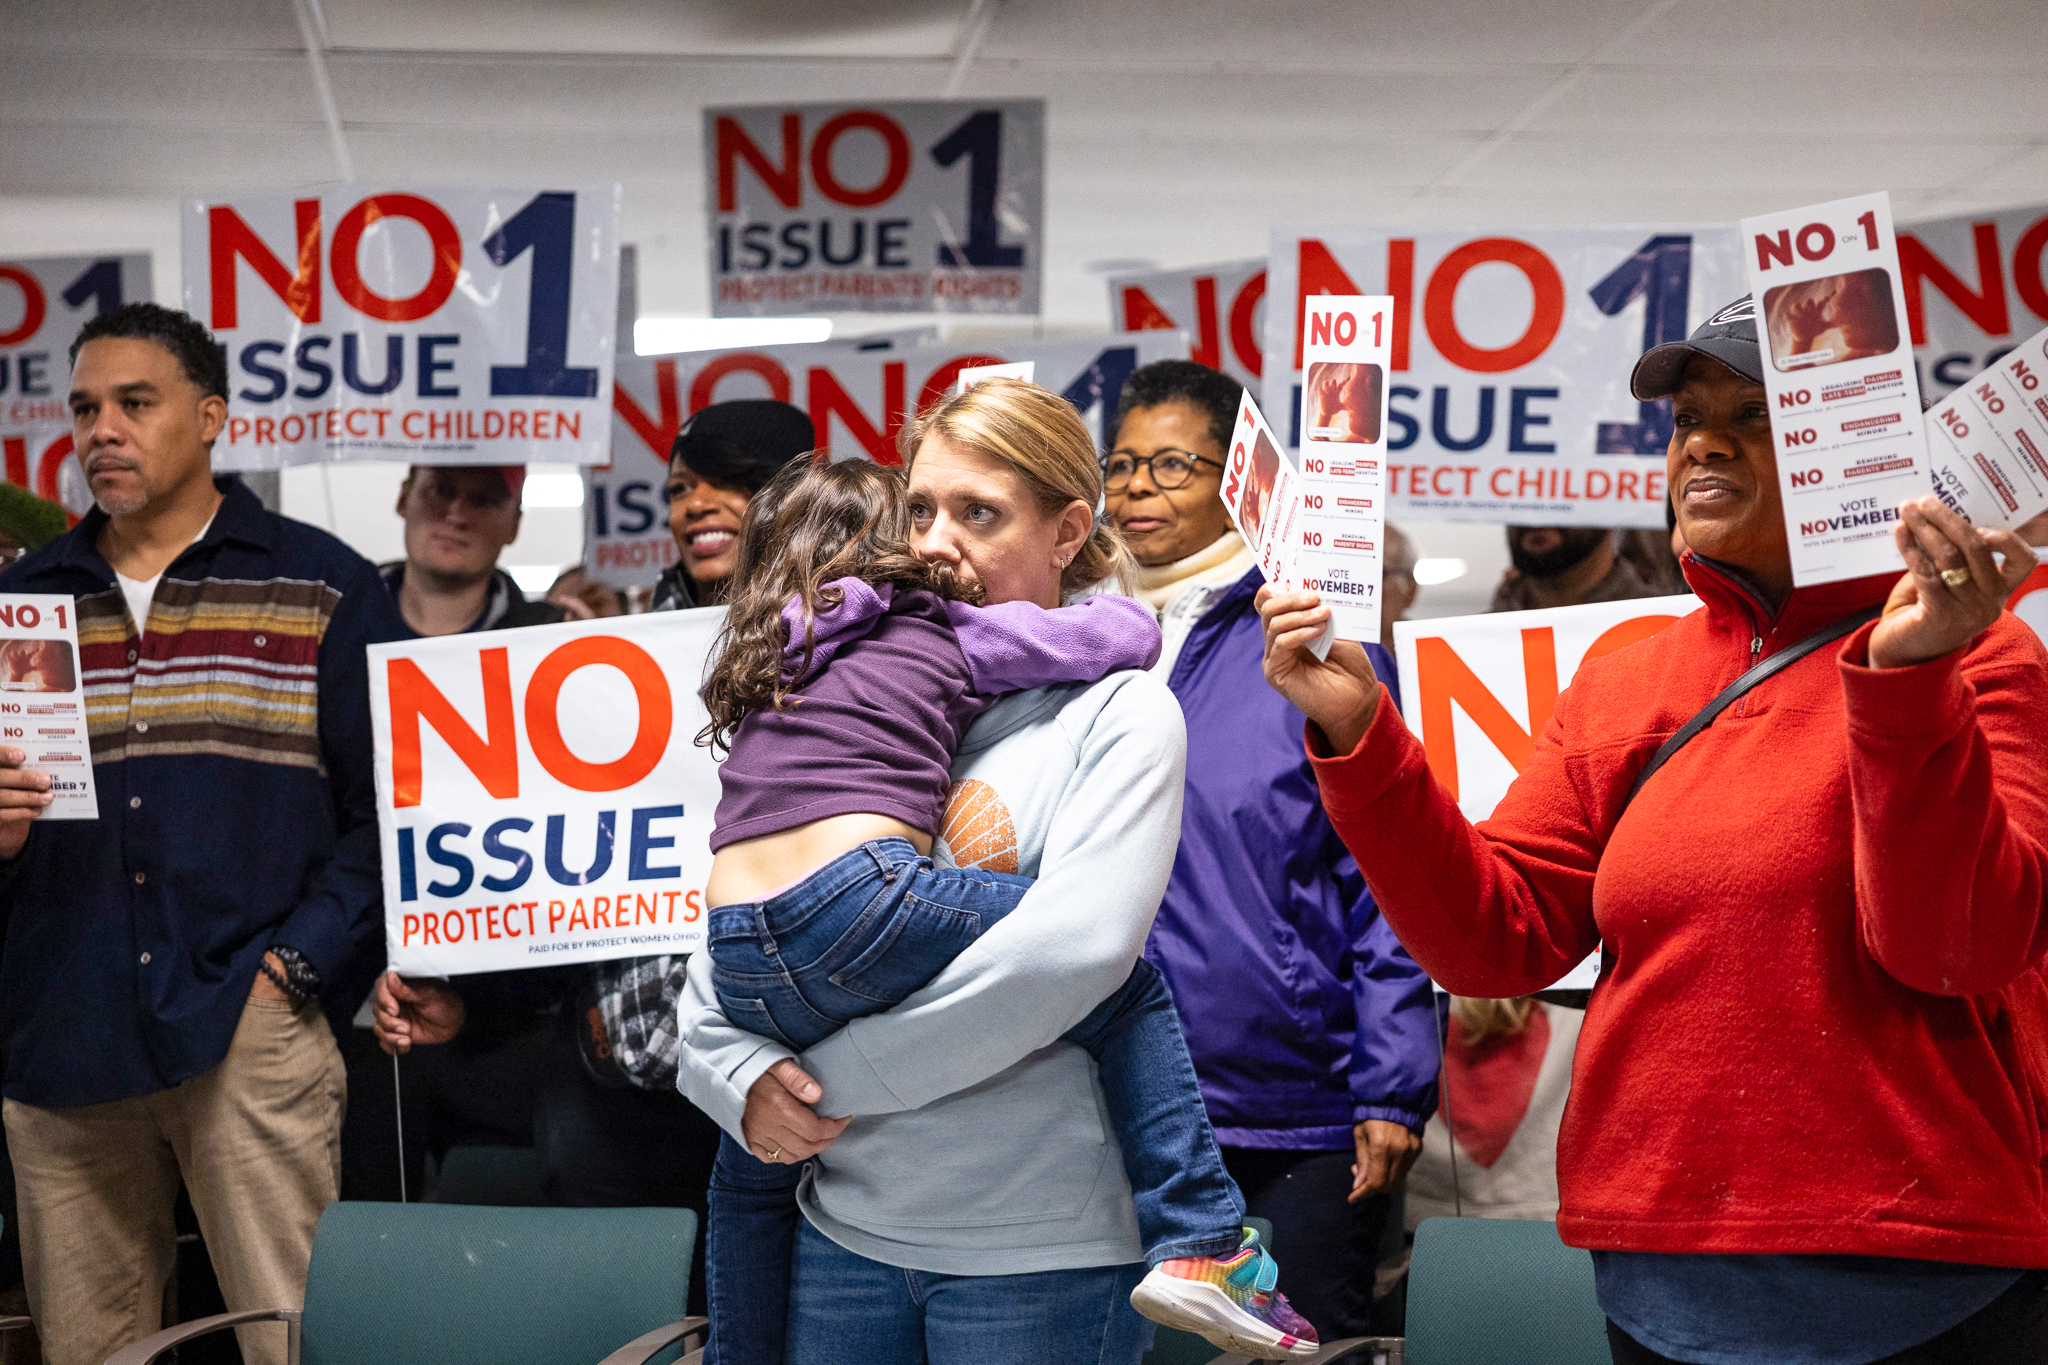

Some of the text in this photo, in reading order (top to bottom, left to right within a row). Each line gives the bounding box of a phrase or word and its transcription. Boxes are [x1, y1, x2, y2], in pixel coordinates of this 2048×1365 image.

[717, 109, 1023, 267] NO 1
[719, 220, 910, 273] ISSUE
[1755, 222, 1835, 271] NO
[1857, 210, 1880, 252] 1
[209, 191, 599, 398] NO 1
[1311, 312, 1357, 347] NO
[1372, 311, 1383, 347] 1
[1589, 234, 1694, 456] 1
[2010, 359, 2039, 391] NO
[1779, 389, 1811, 408] NO
[1976, 382, 2005, 414] NO
[229, 409, 581, 446] PROTECT CHILDREN
[1785, 428, 1817, 447] NO
[1940, 407, 1969, 438] NO
[1226, 406, 1255, 508] NO 1
[1306, 459, 1324, 473] NO
[1386, 464, 1666, 501] TECT CHILDRE
[1790, 468, 1823, 488] NO
[1940, 465, 1969, 499] VOTE
[1305, 495, 1323, 509] NO
[1840, 497, 1877, 512] VOTE
[1303, 532, 1322, 546] NO
[1264, 543, 1271, 569] NO
[1303, 578, 1374, 596] NOVEMBER 7
[1328, 568, 1349, 579] VOTE
[0, 604, 41, 628] NO
[54, 605, 67, 629] 1
[1, 703, 21, 713] NO
[387, 635, 673, 809] NO
[4, 727, 24, 737] NO
[80, 782, 87, 790] 7
[397, 804, 684, 902] ISSUE
[403, 890, 700, 946] PROTECT PARENTS
[529, 932, 701, 954] PAID FOR BY PROTECT WOMEN OHIO
